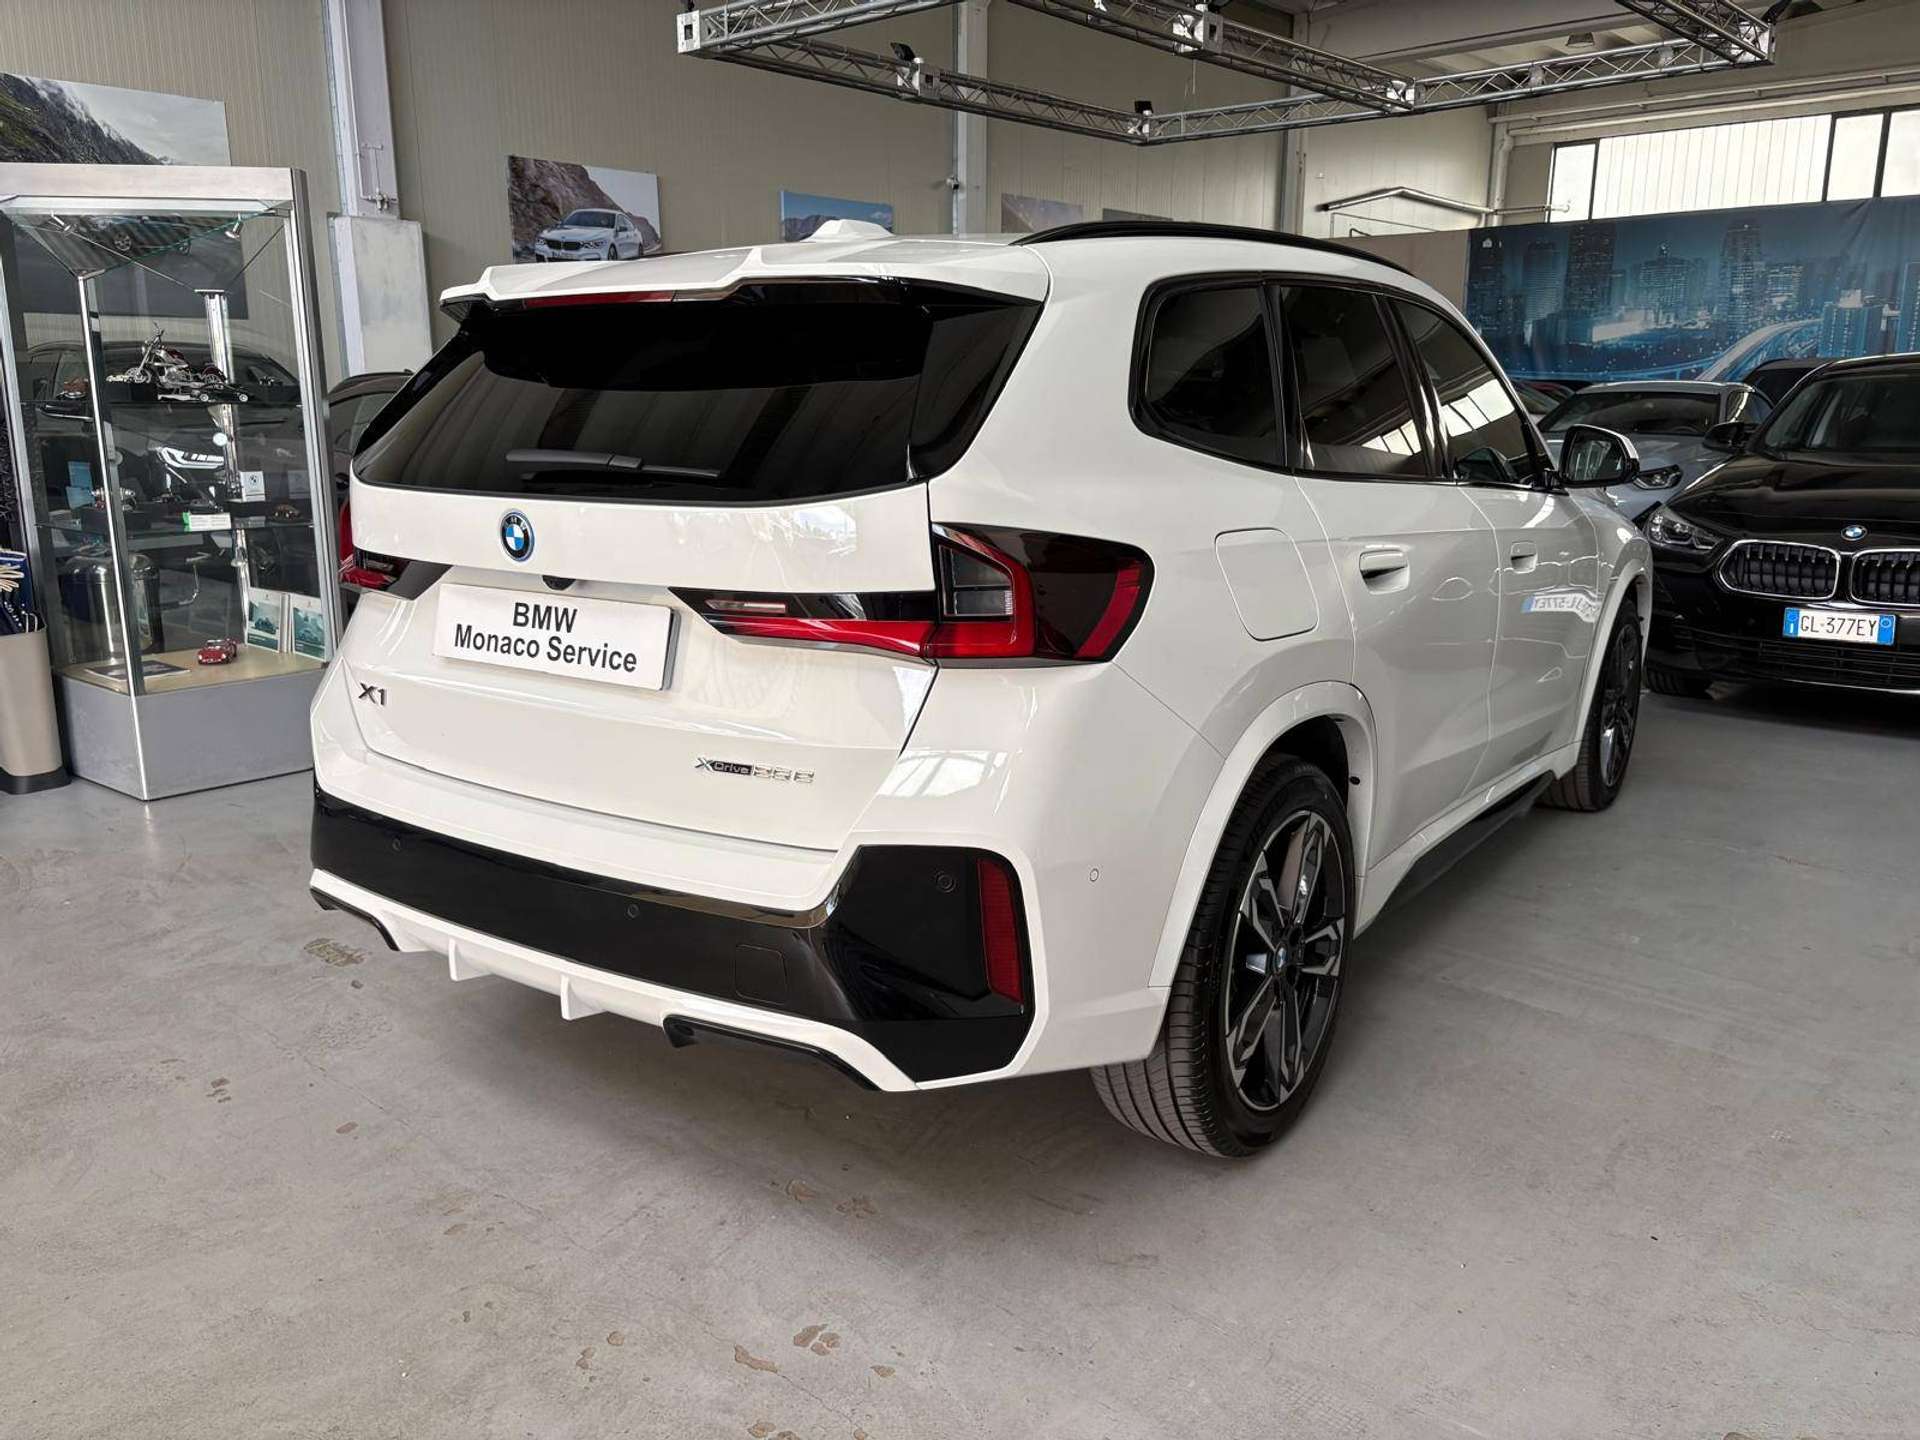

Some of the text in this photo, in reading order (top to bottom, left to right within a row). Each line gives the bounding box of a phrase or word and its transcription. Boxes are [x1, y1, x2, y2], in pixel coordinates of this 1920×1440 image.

[512, 601, 578, 633] BMW
[454, 623, 637, 673] Monaco Service
[358, 682, 387, 706] X1
